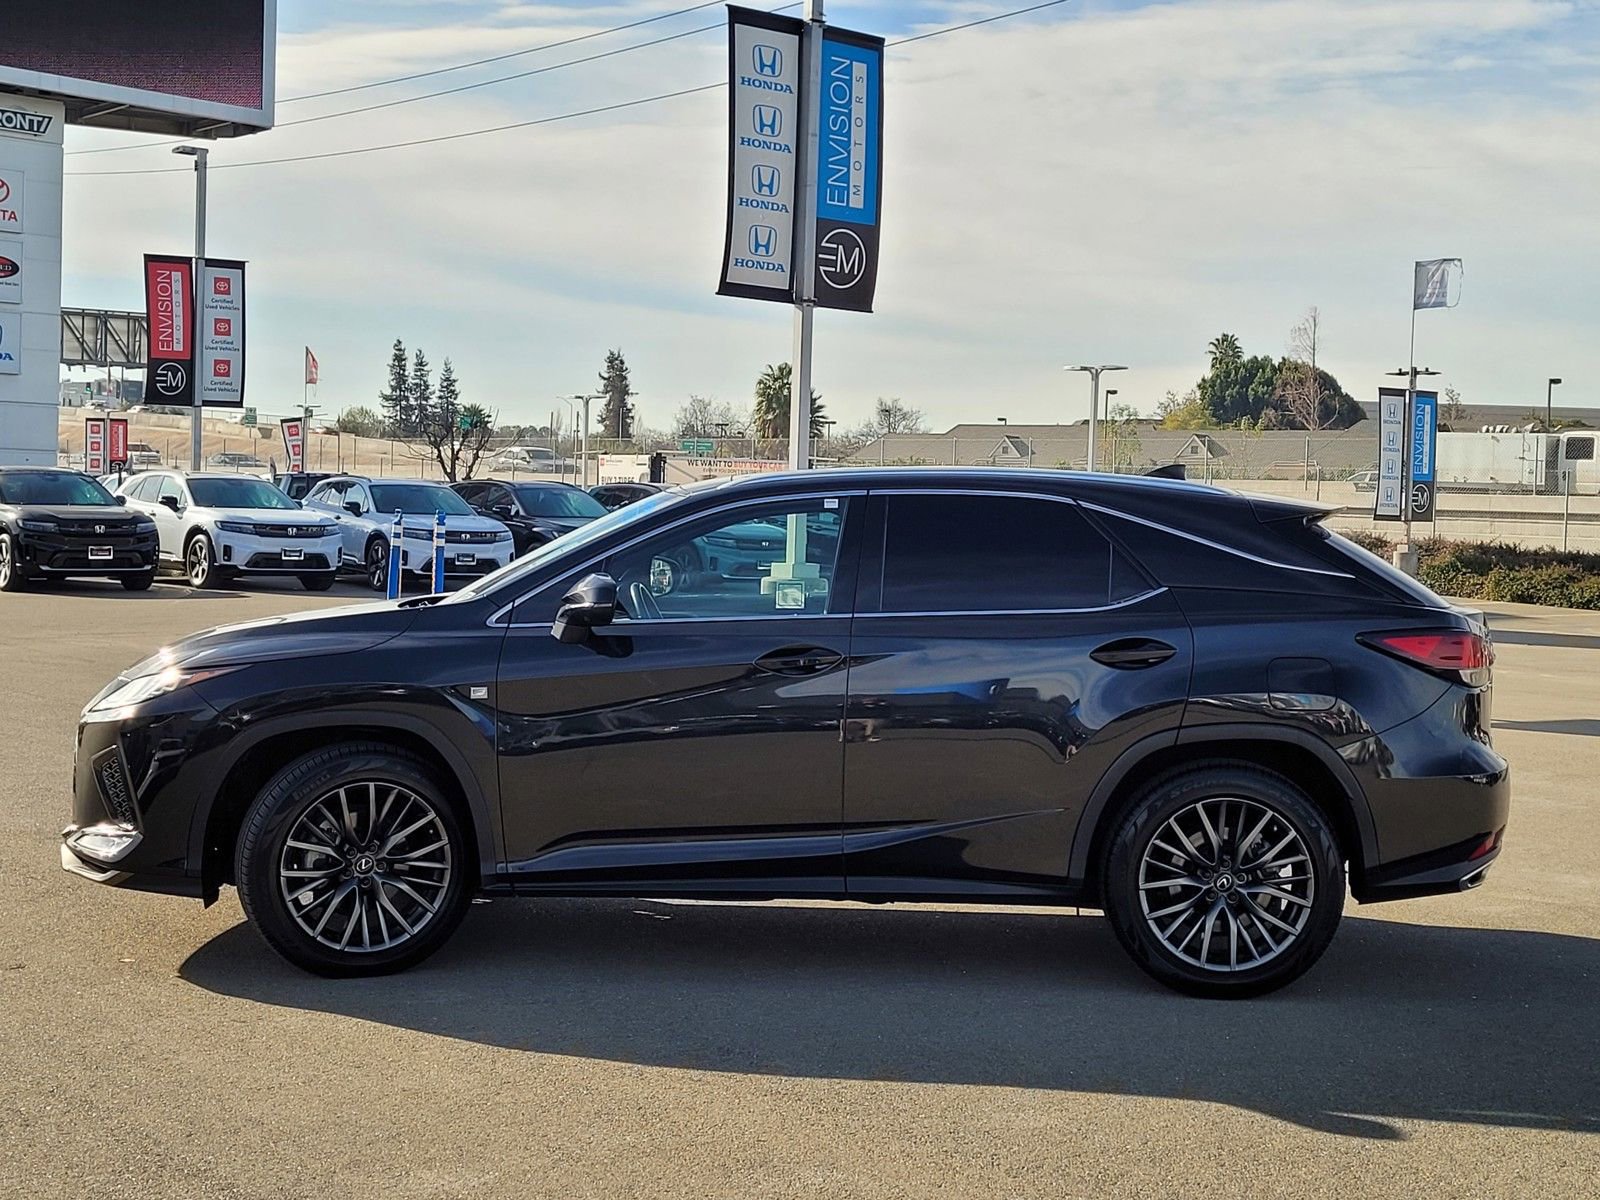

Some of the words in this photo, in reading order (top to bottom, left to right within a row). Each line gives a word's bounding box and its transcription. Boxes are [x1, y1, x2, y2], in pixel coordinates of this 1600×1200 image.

[740, 76, 794, 95] HONDA
[827, 56, 851, 207] ENVISION
[852, 75, 864, 196] MOTORS
[740, 136, 792, 154] HONDA
[738, 197, 789, 214] HONDA
[733, 257, 786, 273] HONDA
[156, 270, 173, 351] ENVISION
[1414, 404, 1425, 474] ENVISION
[700, 459, 722, 467] WANT
